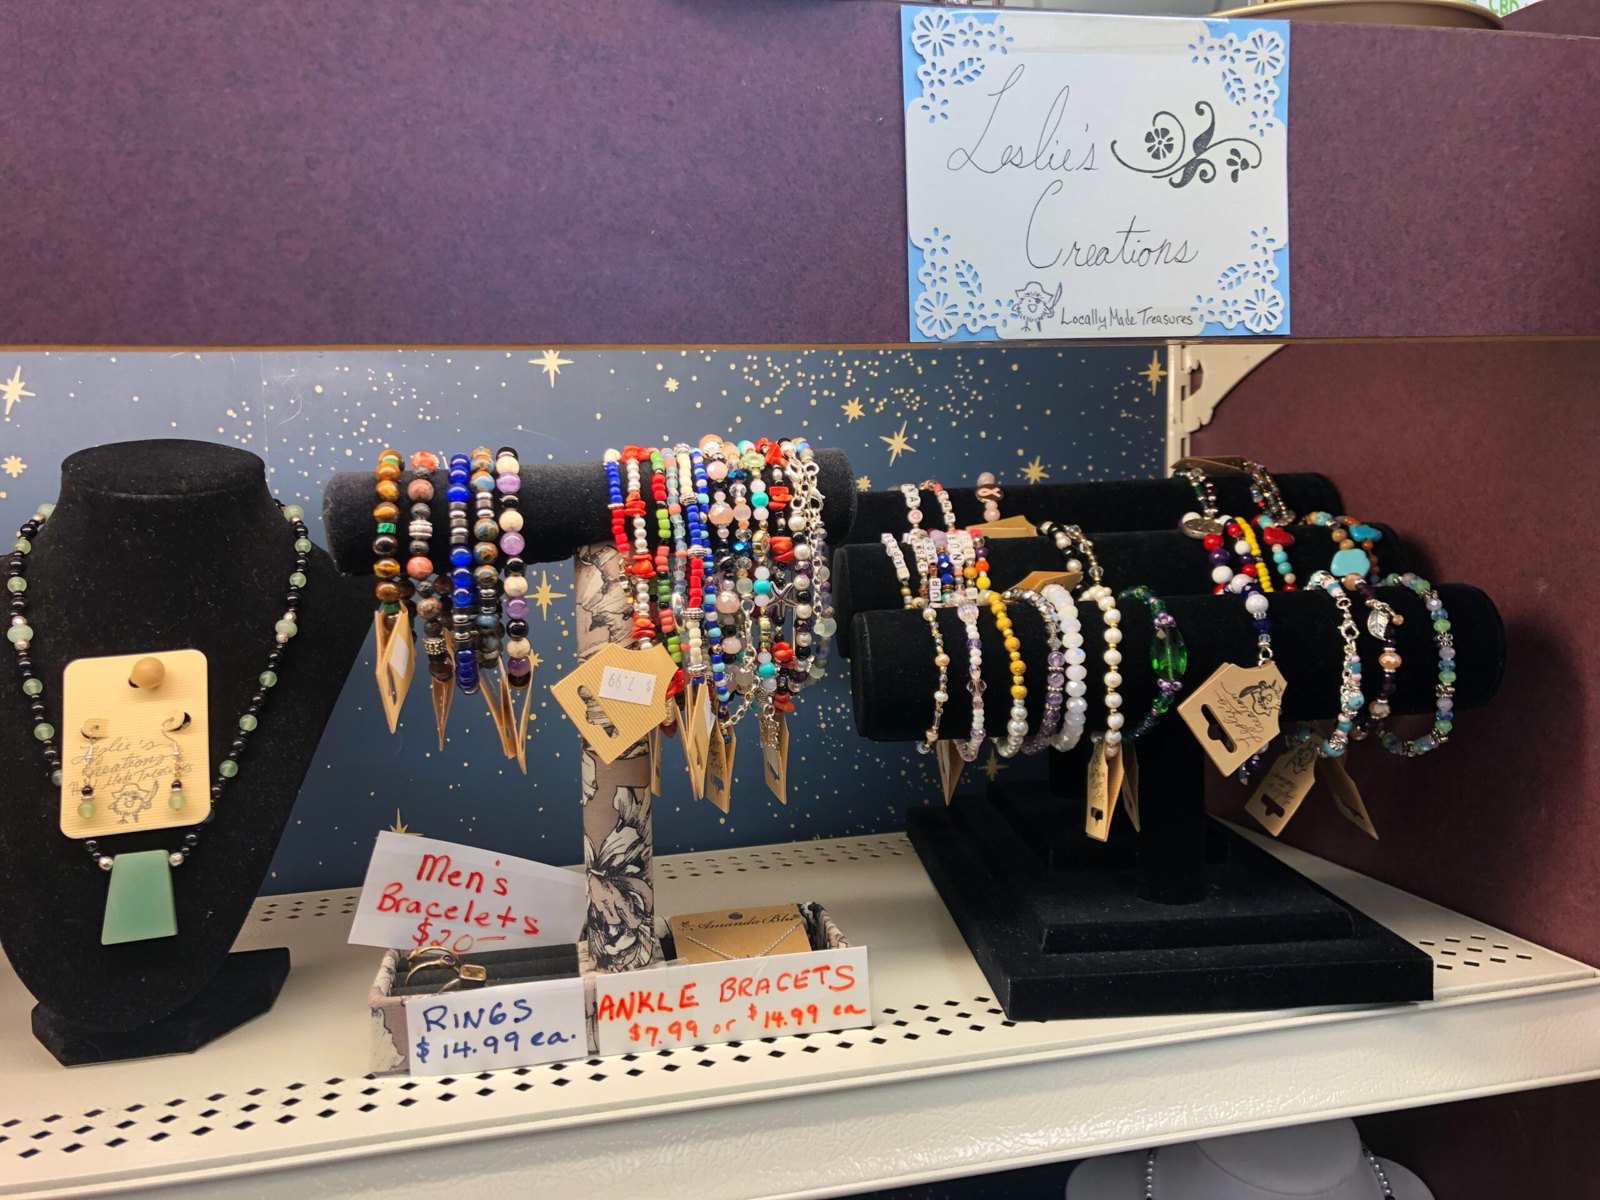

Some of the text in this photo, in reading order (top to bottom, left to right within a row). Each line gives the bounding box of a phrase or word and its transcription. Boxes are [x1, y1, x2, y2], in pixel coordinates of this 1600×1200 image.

[947, 64, 1099, 173] Leslie's
[1026, 180, 1199, 268] Creations
[1060, 306, 1194, 331] Locally Made Treasures
[416, 853, 509, 896] Men's
[376, 882, 539, 936] Bracelets
[698, 915, 760, 929] Amanda
[597, 964, 856, 1021] ANKLE BRACETS
[422, 999, 533, 1032] RINGS
[629, 1019, 698, 1047] $7.99
[712, 1019, 736, 1035] or
[748, 1003, 819, 1029] $14.99
[530, 1032, 577, 1047] ea.
